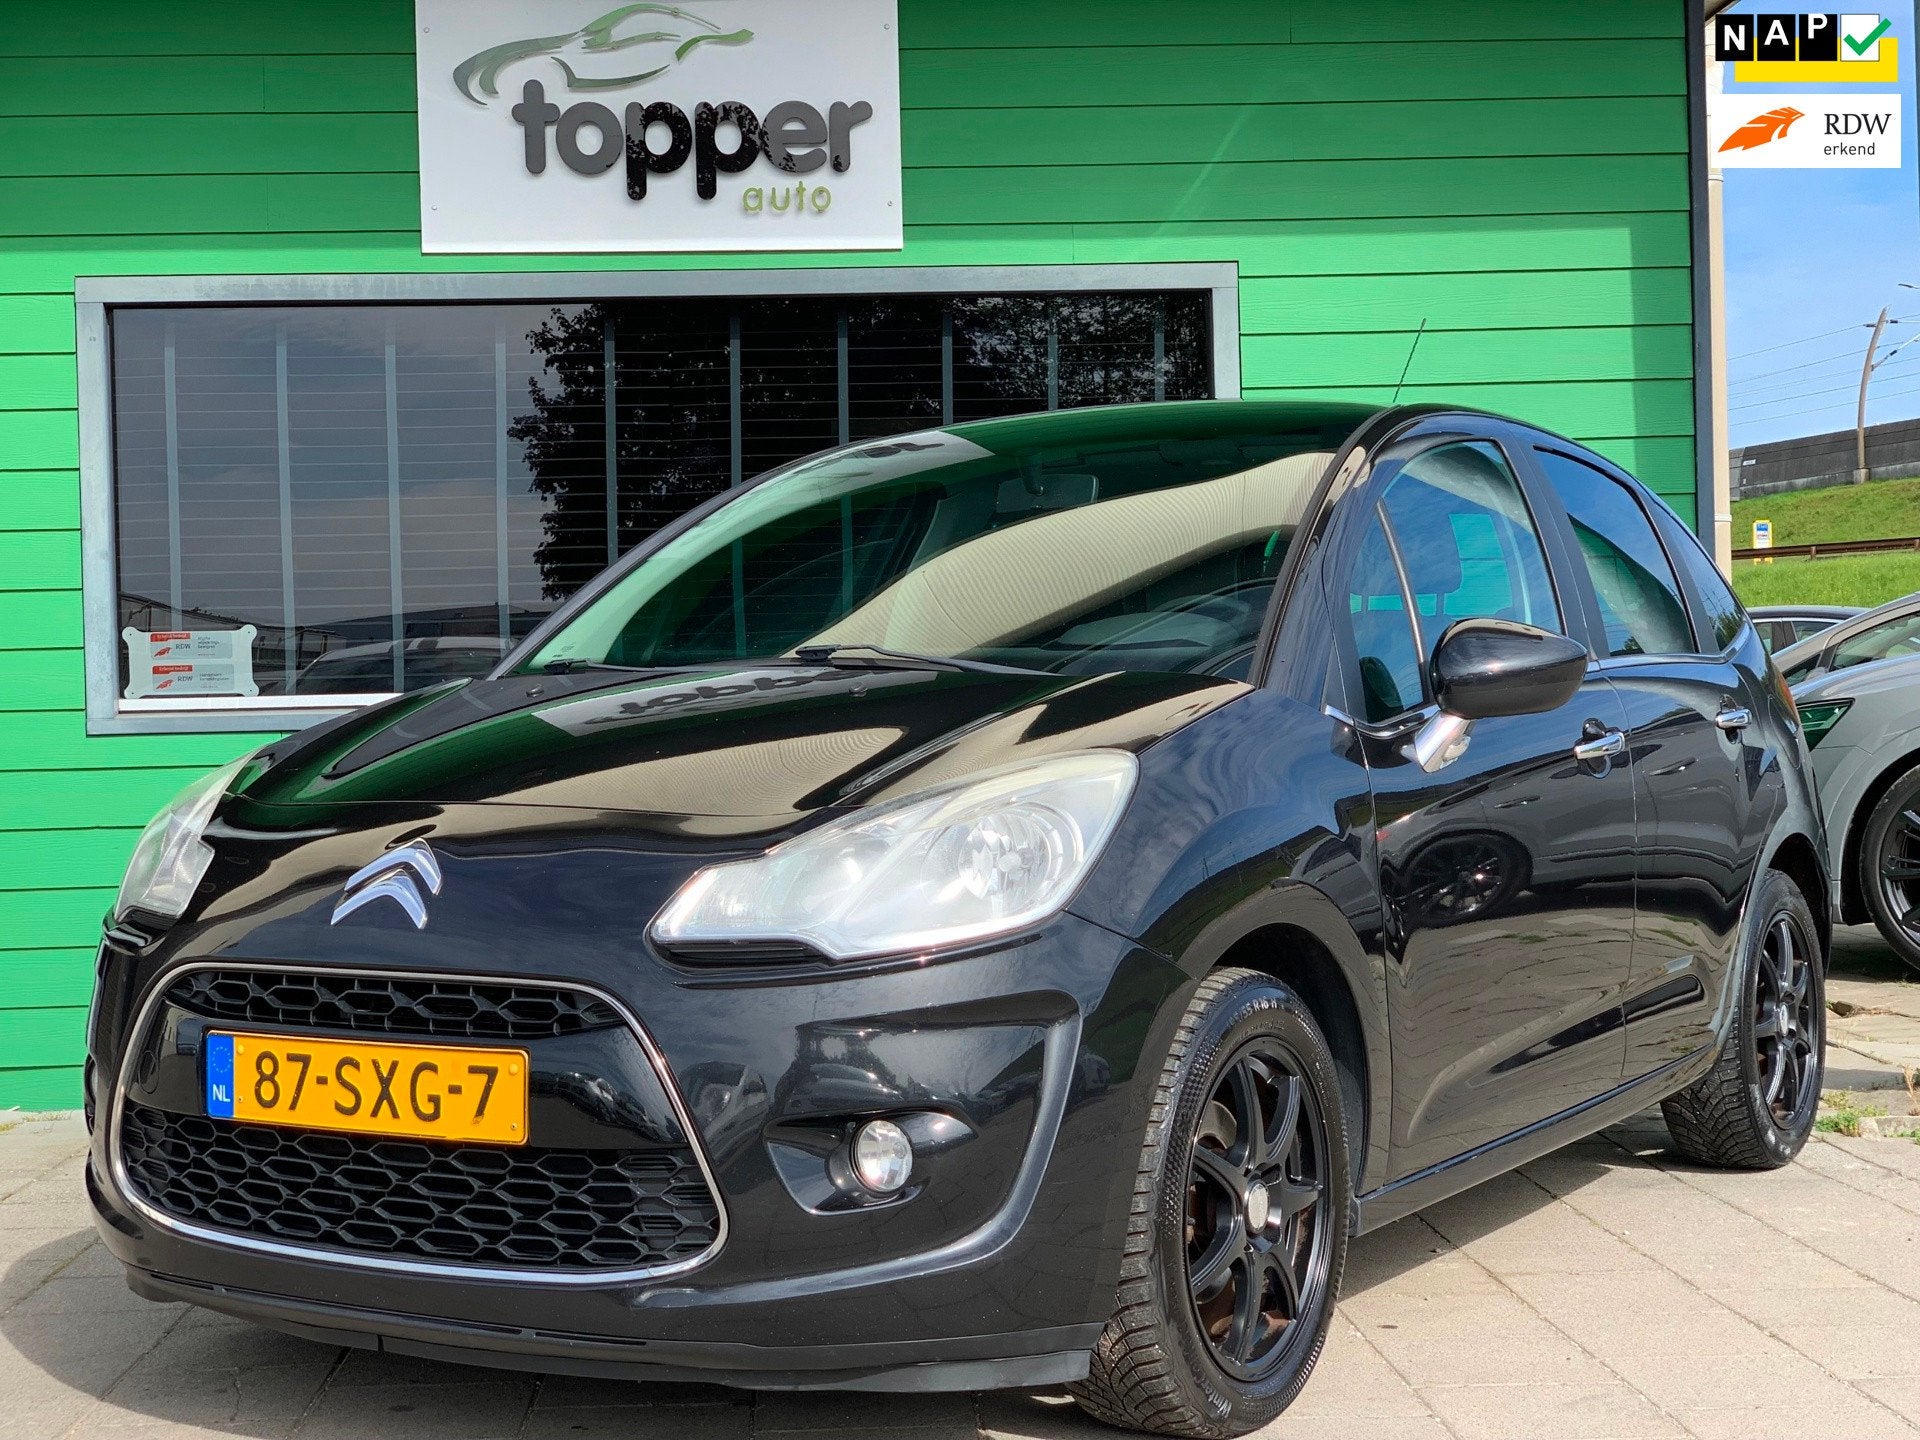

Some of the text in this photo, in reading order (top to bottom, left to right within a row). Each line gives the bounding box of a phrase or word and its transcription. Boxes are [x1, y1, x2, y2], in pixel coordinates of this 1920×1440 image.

[511, 79, 873, 201] topper
[742, 181, 832, 213] auto
[212, 1083, 231, 1103] NL
[254, 1050, 499, 1126] 87-SXG-7
